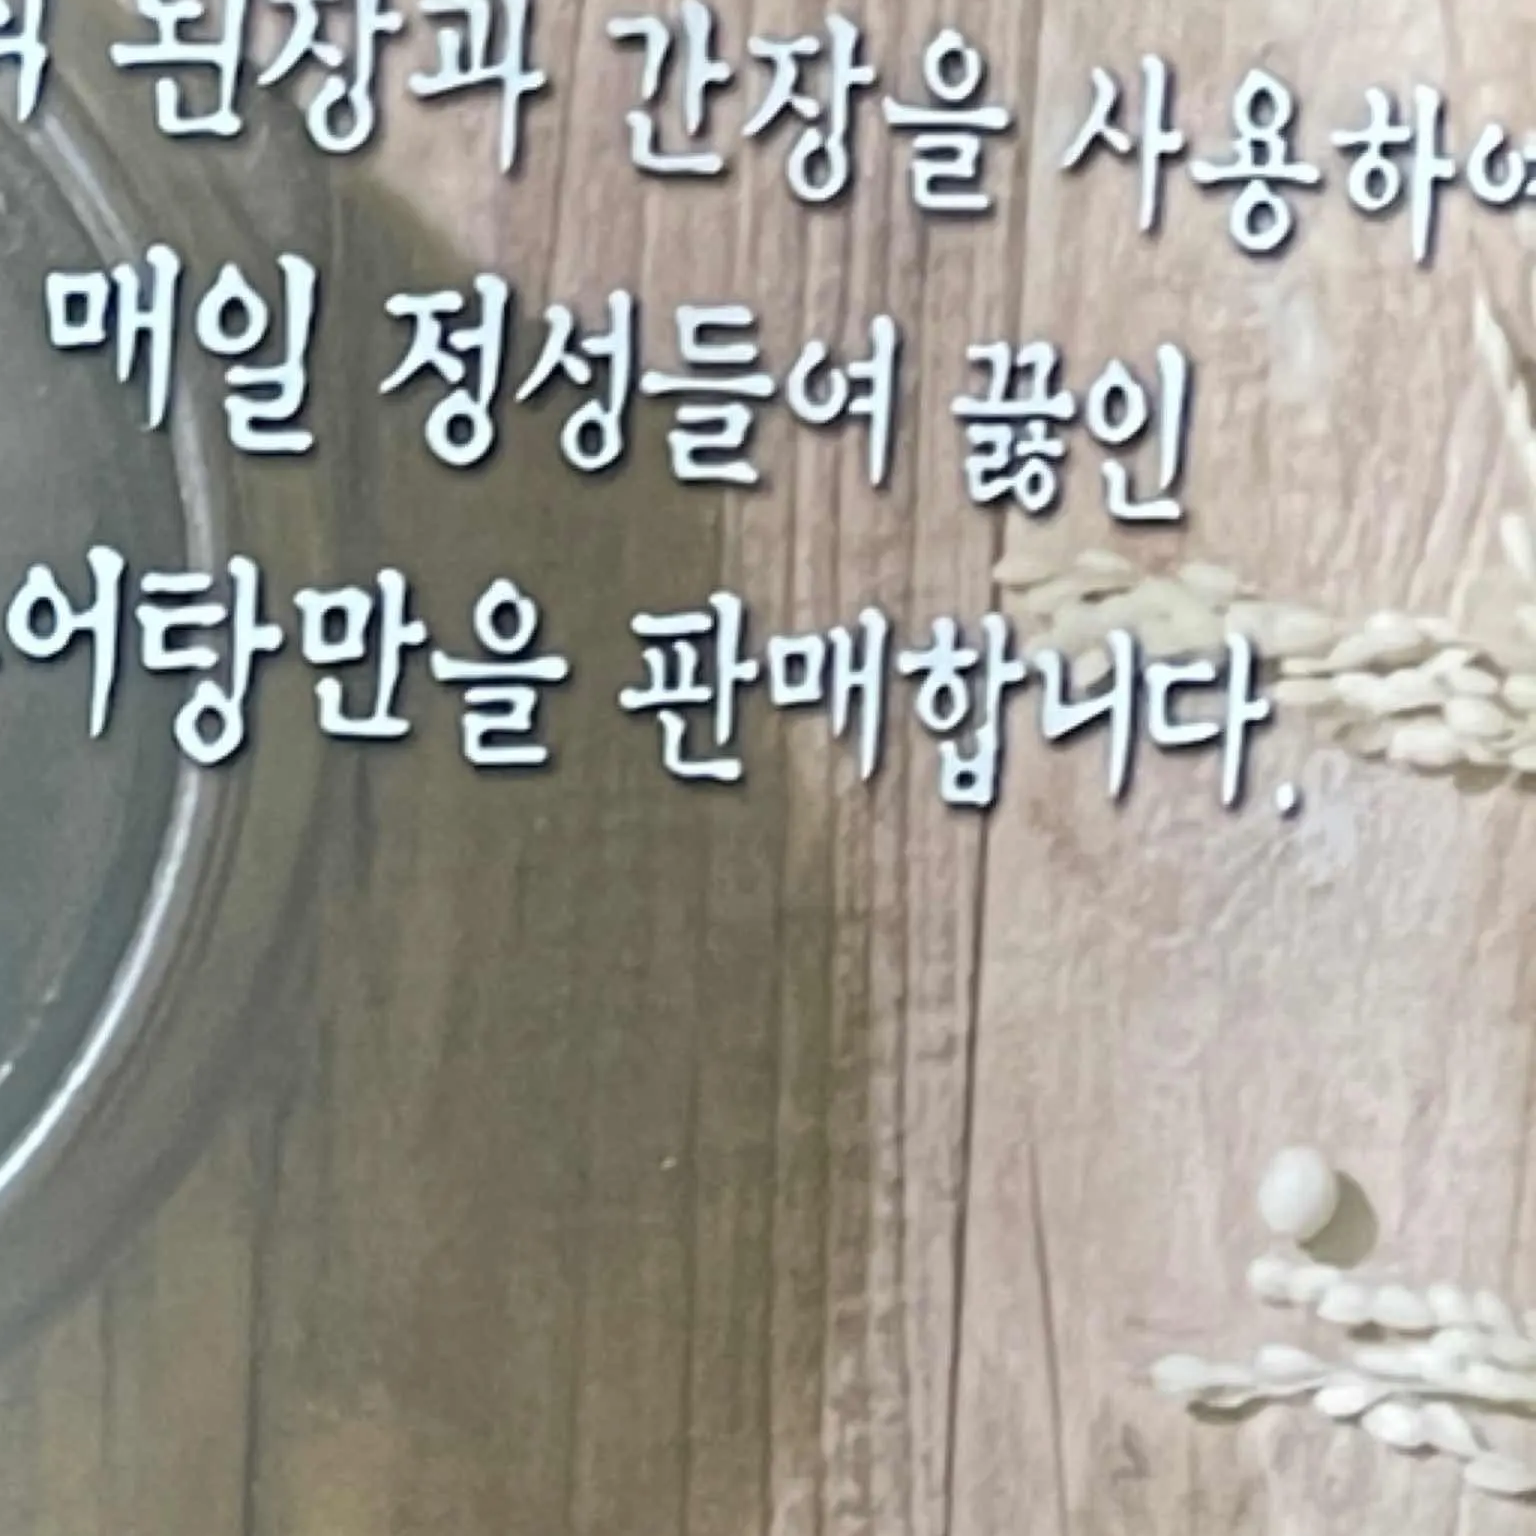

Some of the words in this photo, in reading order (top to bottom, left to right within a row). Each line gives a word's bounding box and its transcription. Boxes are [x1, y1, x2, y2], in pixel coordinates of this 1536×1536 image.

[45, 243, 315, 452] 매일
[378, 273, 896, 485] 정성들여
[949, 339, 1185, 519] 끓인
[618, 591, 1305, 811] 판매합니다.
